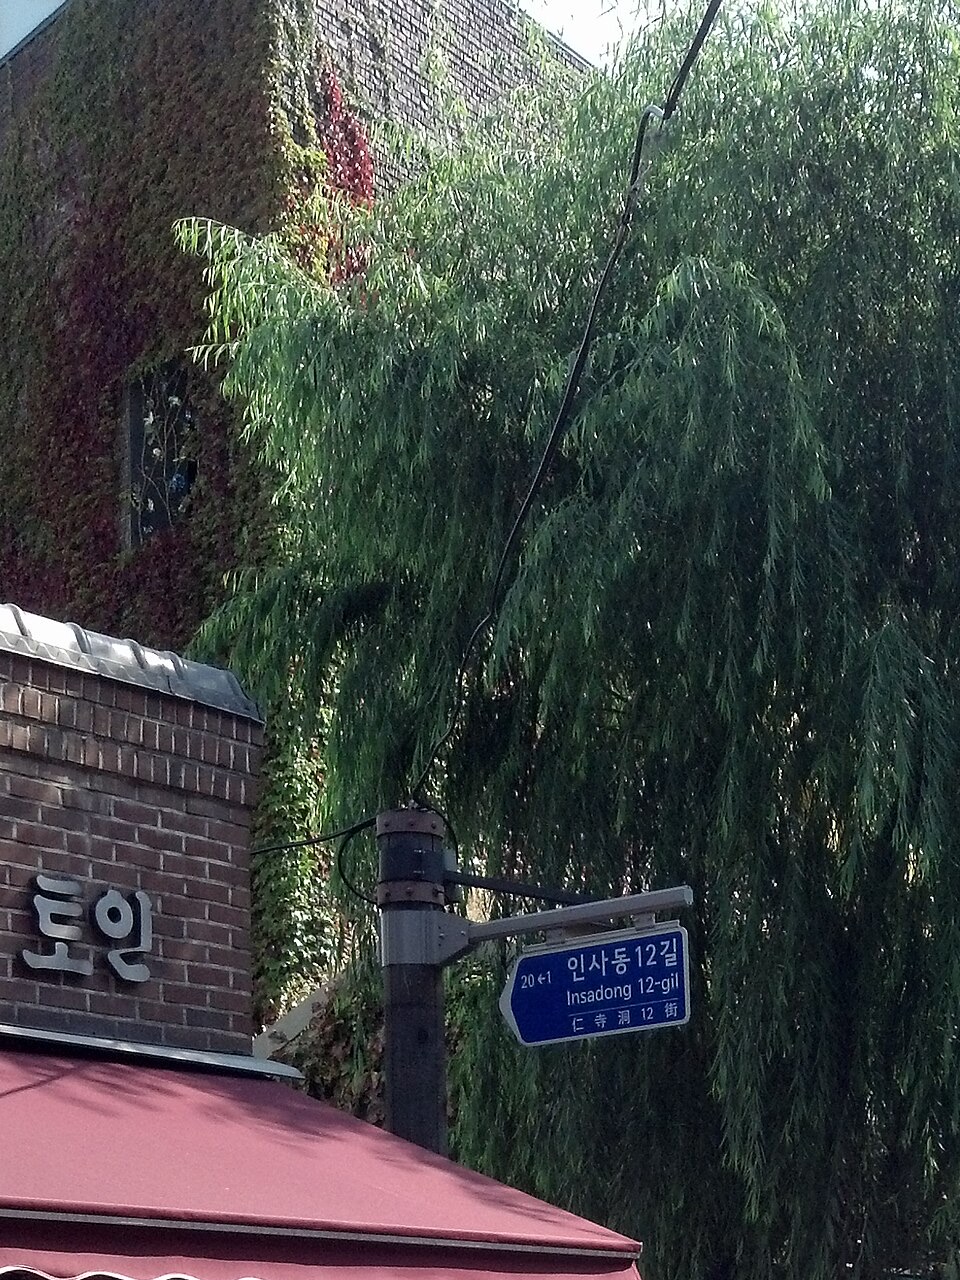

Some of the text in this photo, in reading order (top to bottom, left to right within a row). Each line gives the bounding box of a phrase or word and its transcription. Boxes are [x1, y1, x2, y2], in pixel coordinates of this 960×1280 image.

[23, 875, 153, 981] 토인
[567, 973, 679, 1006] Insadong 12-gil
